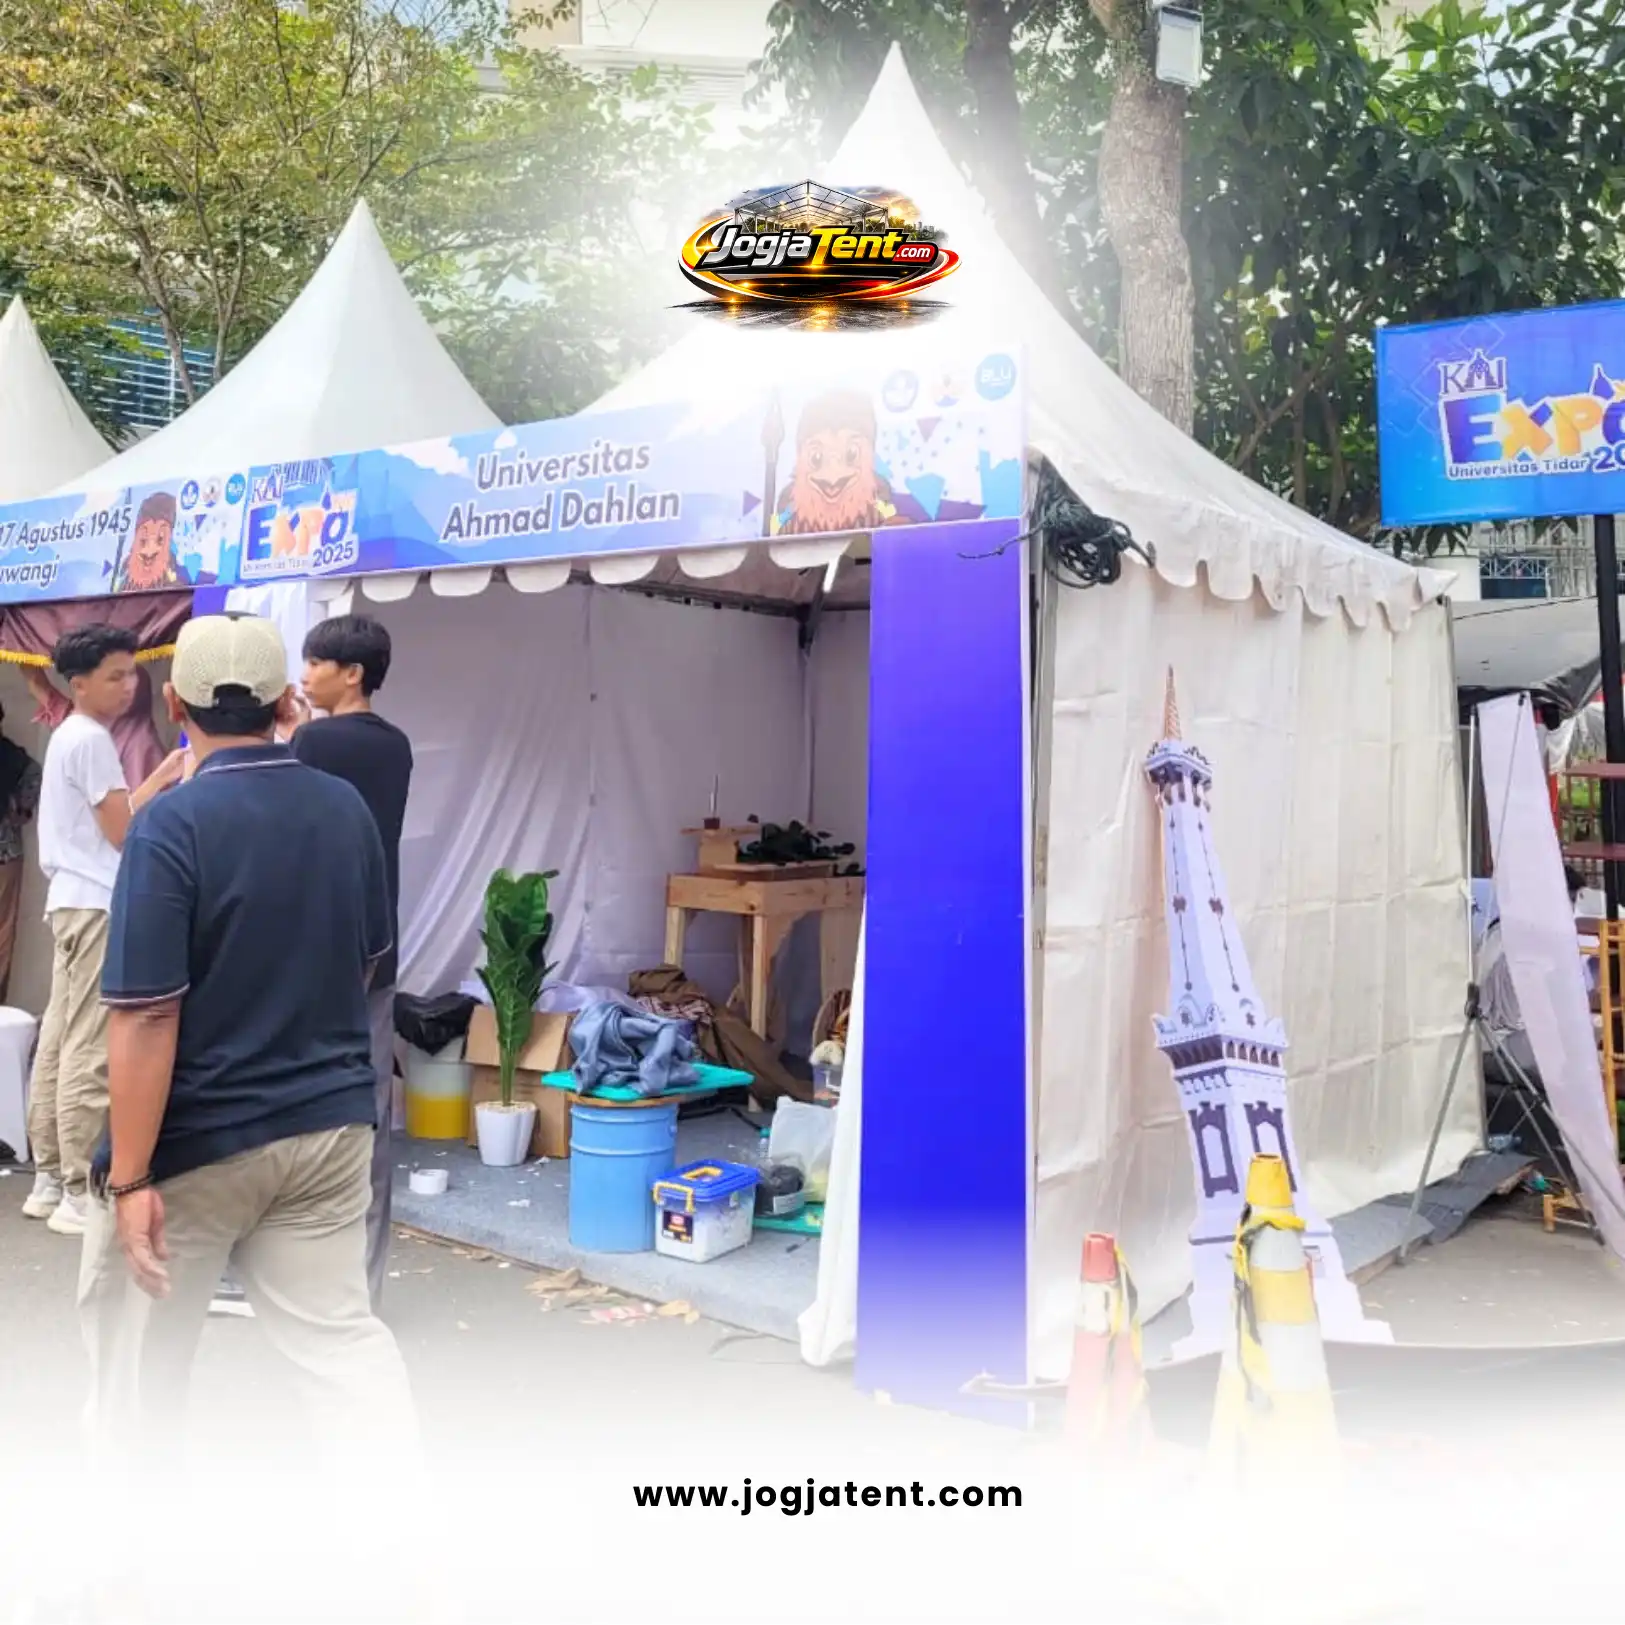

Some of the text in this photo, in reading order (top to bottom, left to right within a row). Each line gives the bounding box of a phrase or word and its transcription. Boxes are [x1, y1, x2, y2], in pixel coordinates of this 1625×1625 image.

[478, 440, 649, 489] Universitas
[1449, 458, 1587, 477] Universitas Tidar
[17, 521, 84, 551] Agustus
[91, 507, 132, 537] 1945
[443, 484, 679, 540] Ahmad Dahlan
[312, 541, 354, 568] 2025
